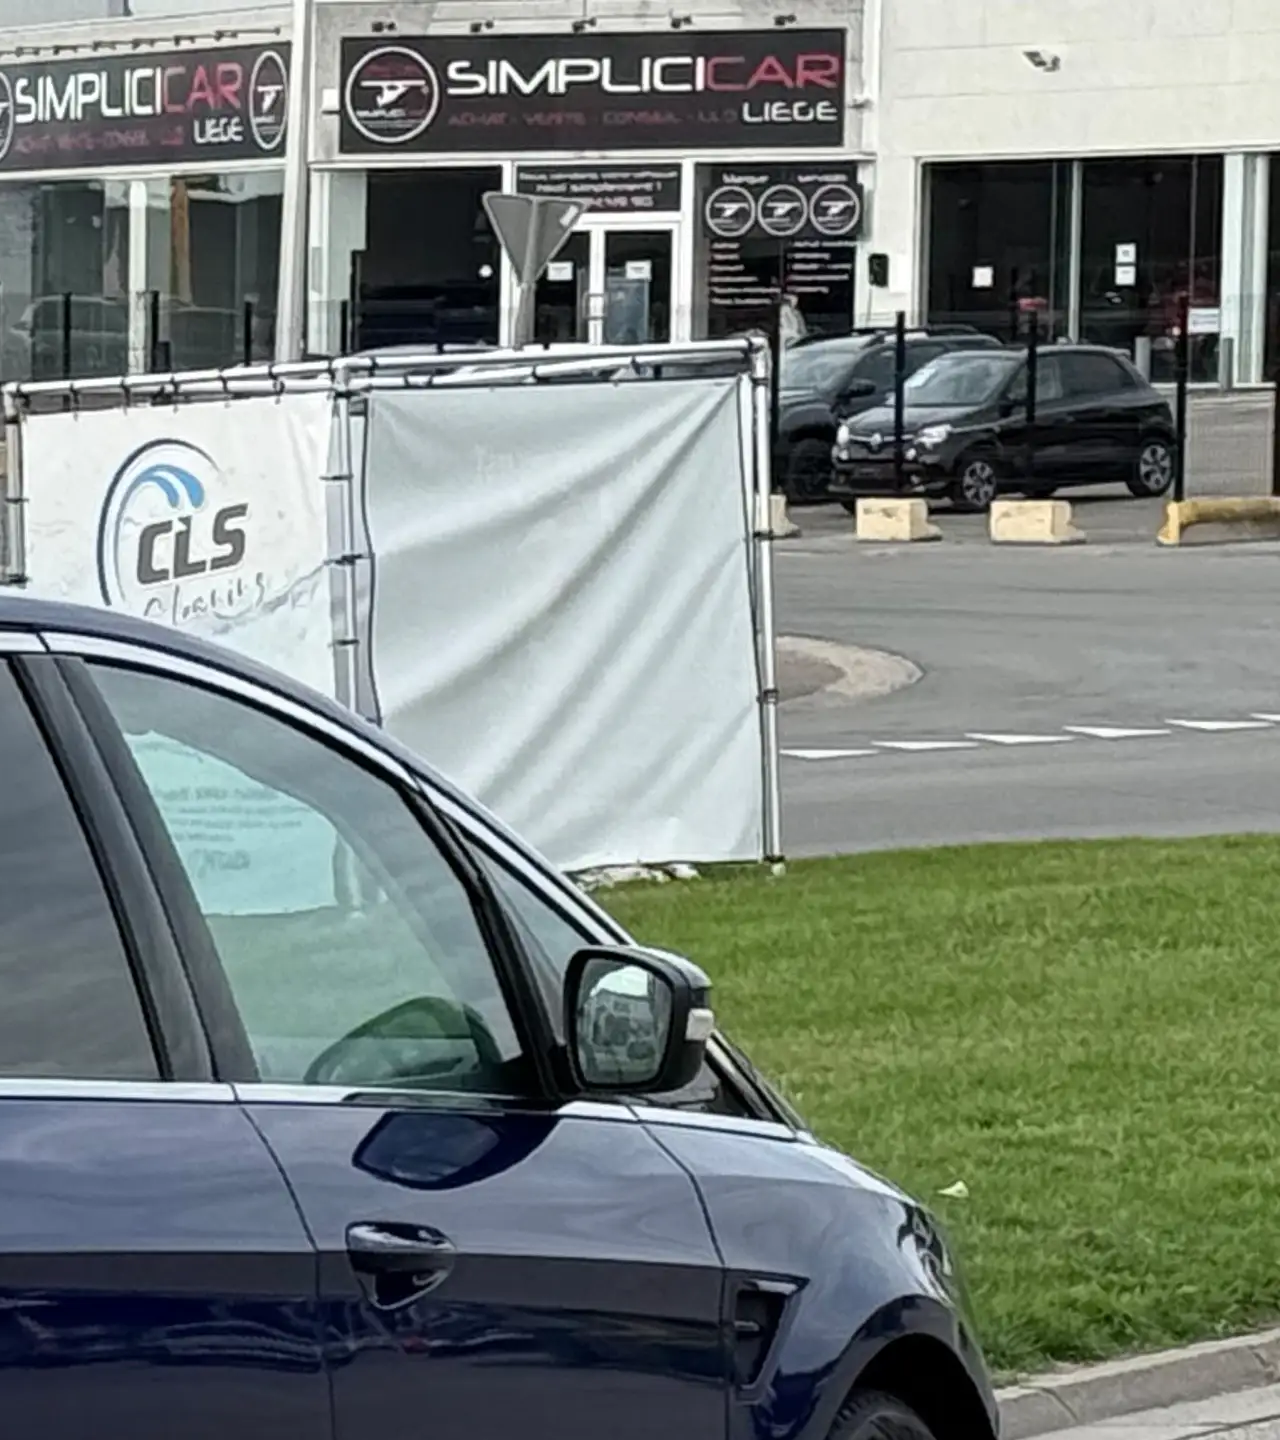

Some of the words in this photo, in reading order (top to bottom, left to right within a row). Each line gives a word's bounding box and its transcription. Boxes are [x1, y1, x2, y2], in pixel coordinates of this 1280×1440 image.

[14, 62, 243, 125] SIMPLICICAR
[446, 53, 840, 95] SIMPLICICAR
[193, 115, 244, 144] LIEGE
[742, 101, 838, 123] LIEGE
[137, 503, 248, 585] CLS
